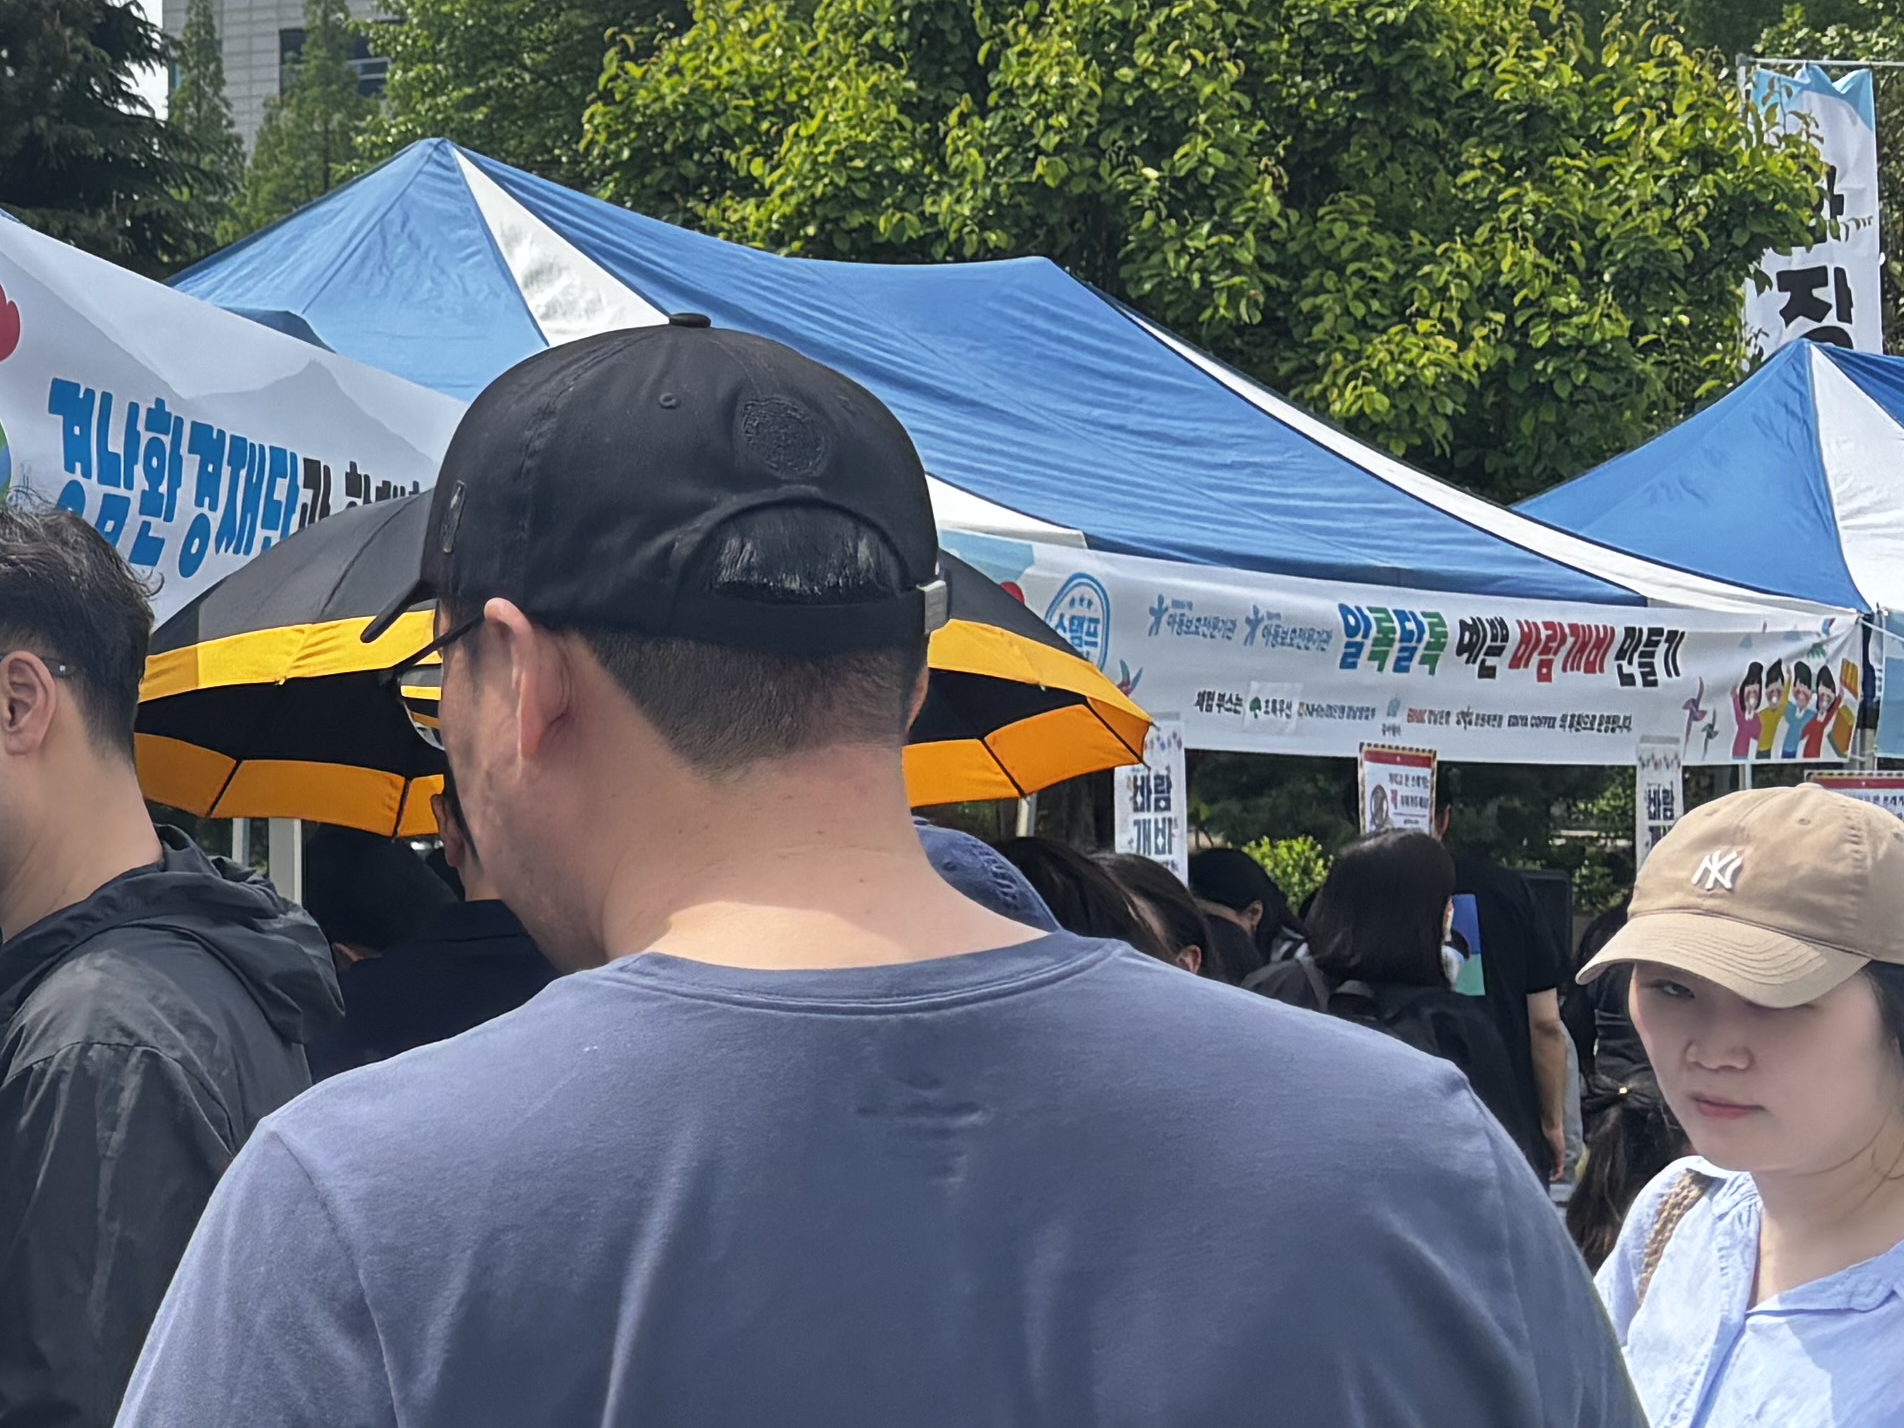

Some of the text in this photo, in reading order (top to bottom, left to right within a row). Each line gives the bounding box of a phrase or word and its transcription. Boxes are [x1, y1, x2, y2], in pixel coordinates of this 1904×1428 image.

[1337, 602, 1449, 676] 알록달록
[1456, 616, 1510, 680] 예쁜
[1508, 619, 1616, 683] 바람개비
